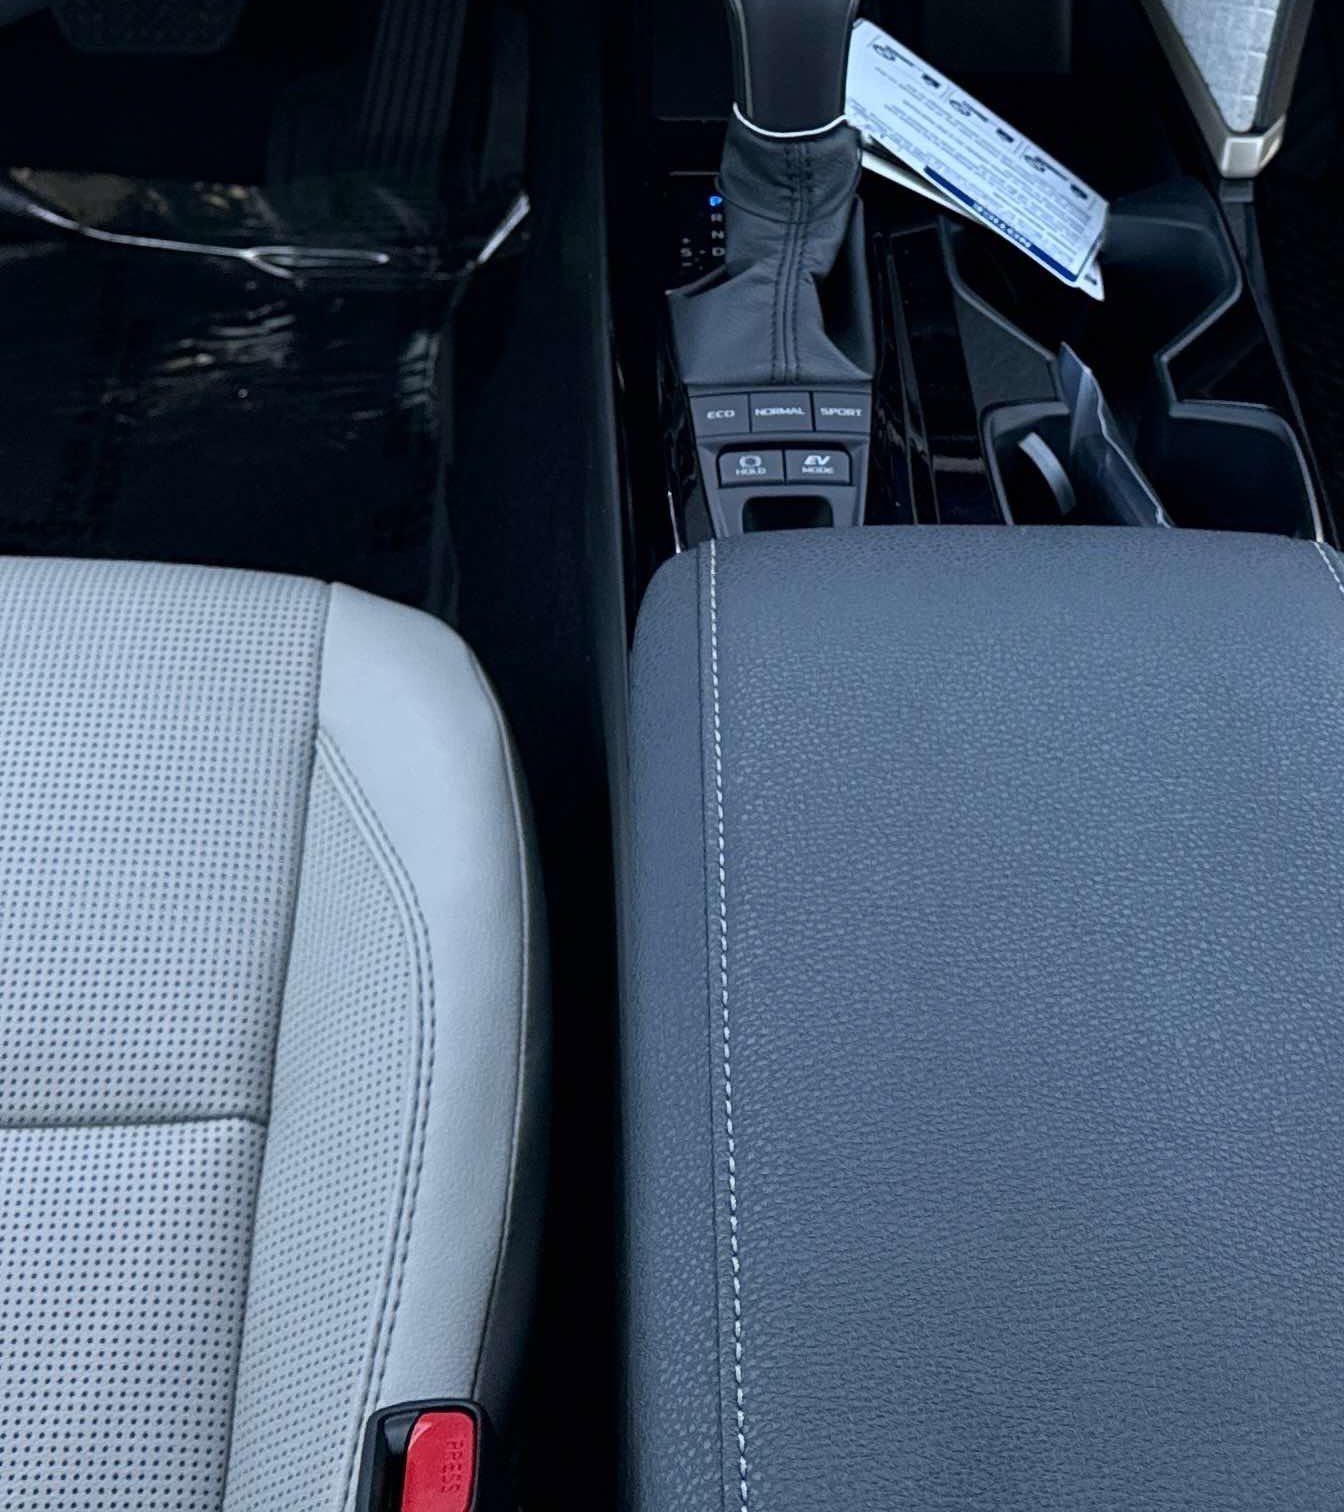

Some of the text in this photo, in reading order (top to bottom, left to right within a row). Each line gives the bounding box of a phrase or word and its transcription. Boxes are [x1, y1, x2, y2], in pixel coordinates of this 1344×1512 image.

[712, 231, 724, 240] N
[712, 247, 725, 257] D
[706, 410, 735, 419] ECO
[755, 407, 805, 416] NORMAL
[820, 407, 862, 417] SPORT
[804, 455, 831, 466] EV
[735, 466, 767, 476] HOLD
